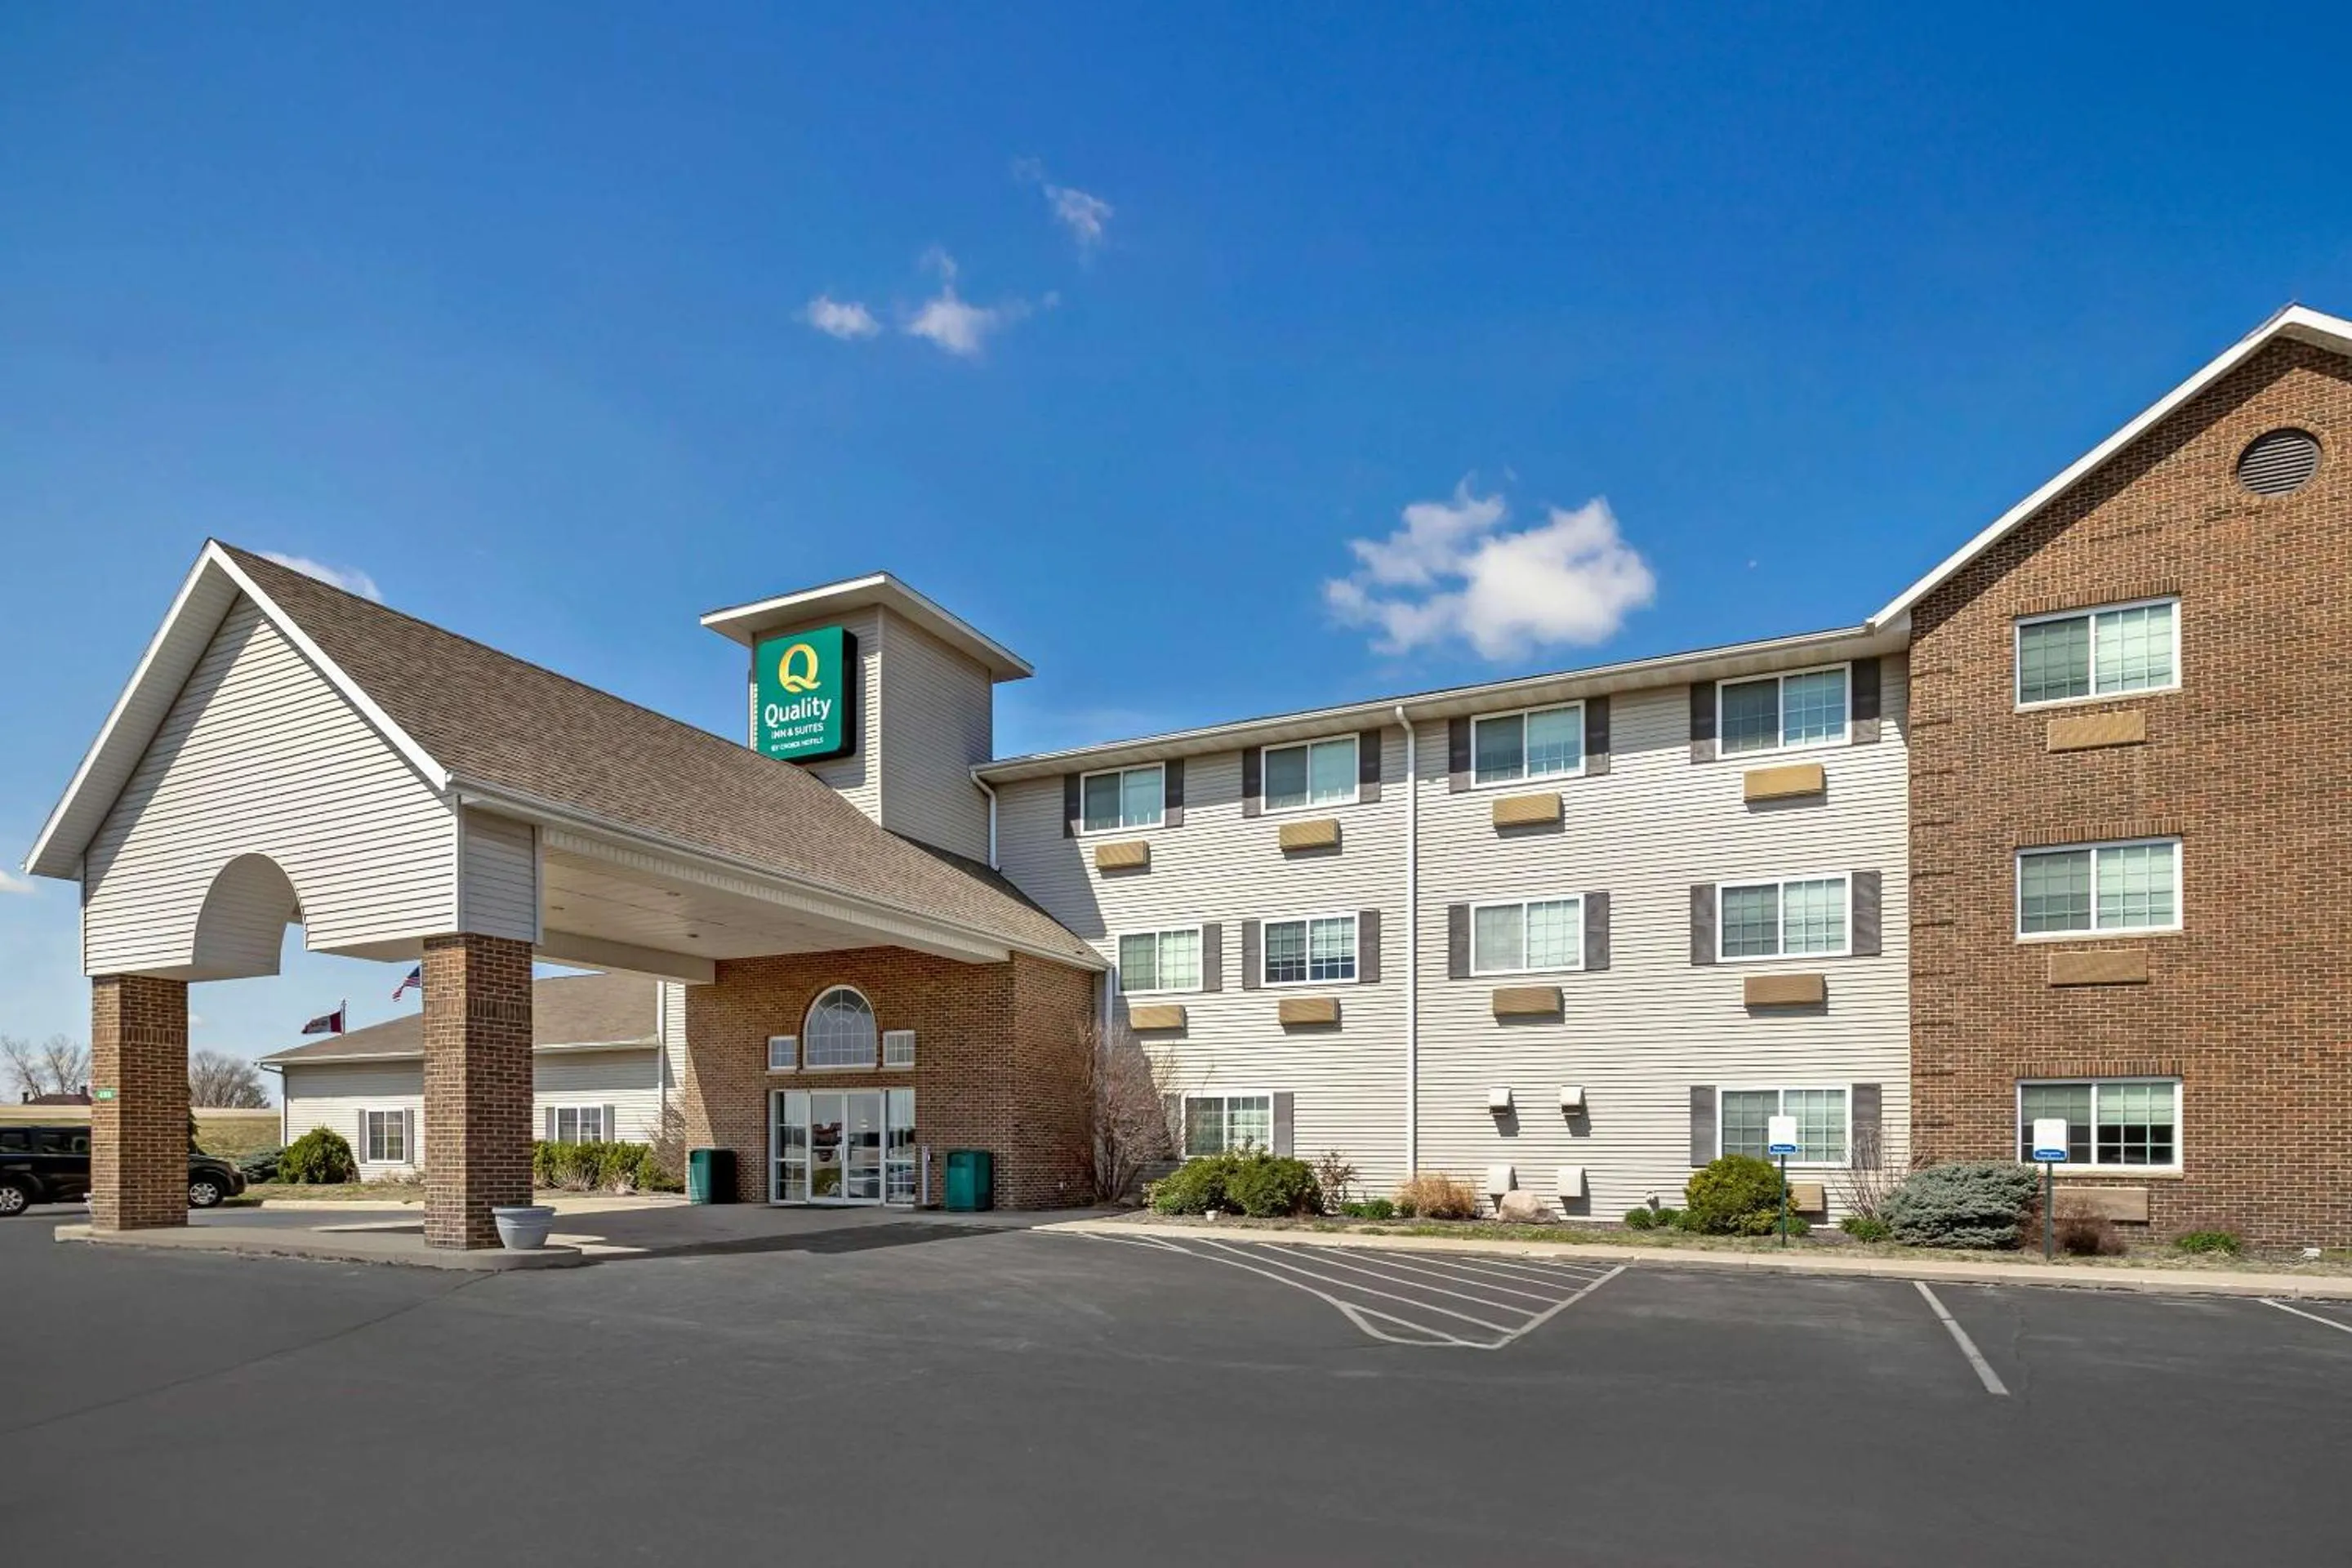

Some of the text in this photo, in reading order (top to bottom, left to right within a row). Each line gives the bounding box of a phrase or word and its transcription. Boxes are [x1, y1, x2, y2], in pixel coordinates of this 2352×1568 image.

[779, 644, 821, 693] Q
[764, 697, 831, 728] Quality
[771, 723, 824, 739] INN & SUITES
